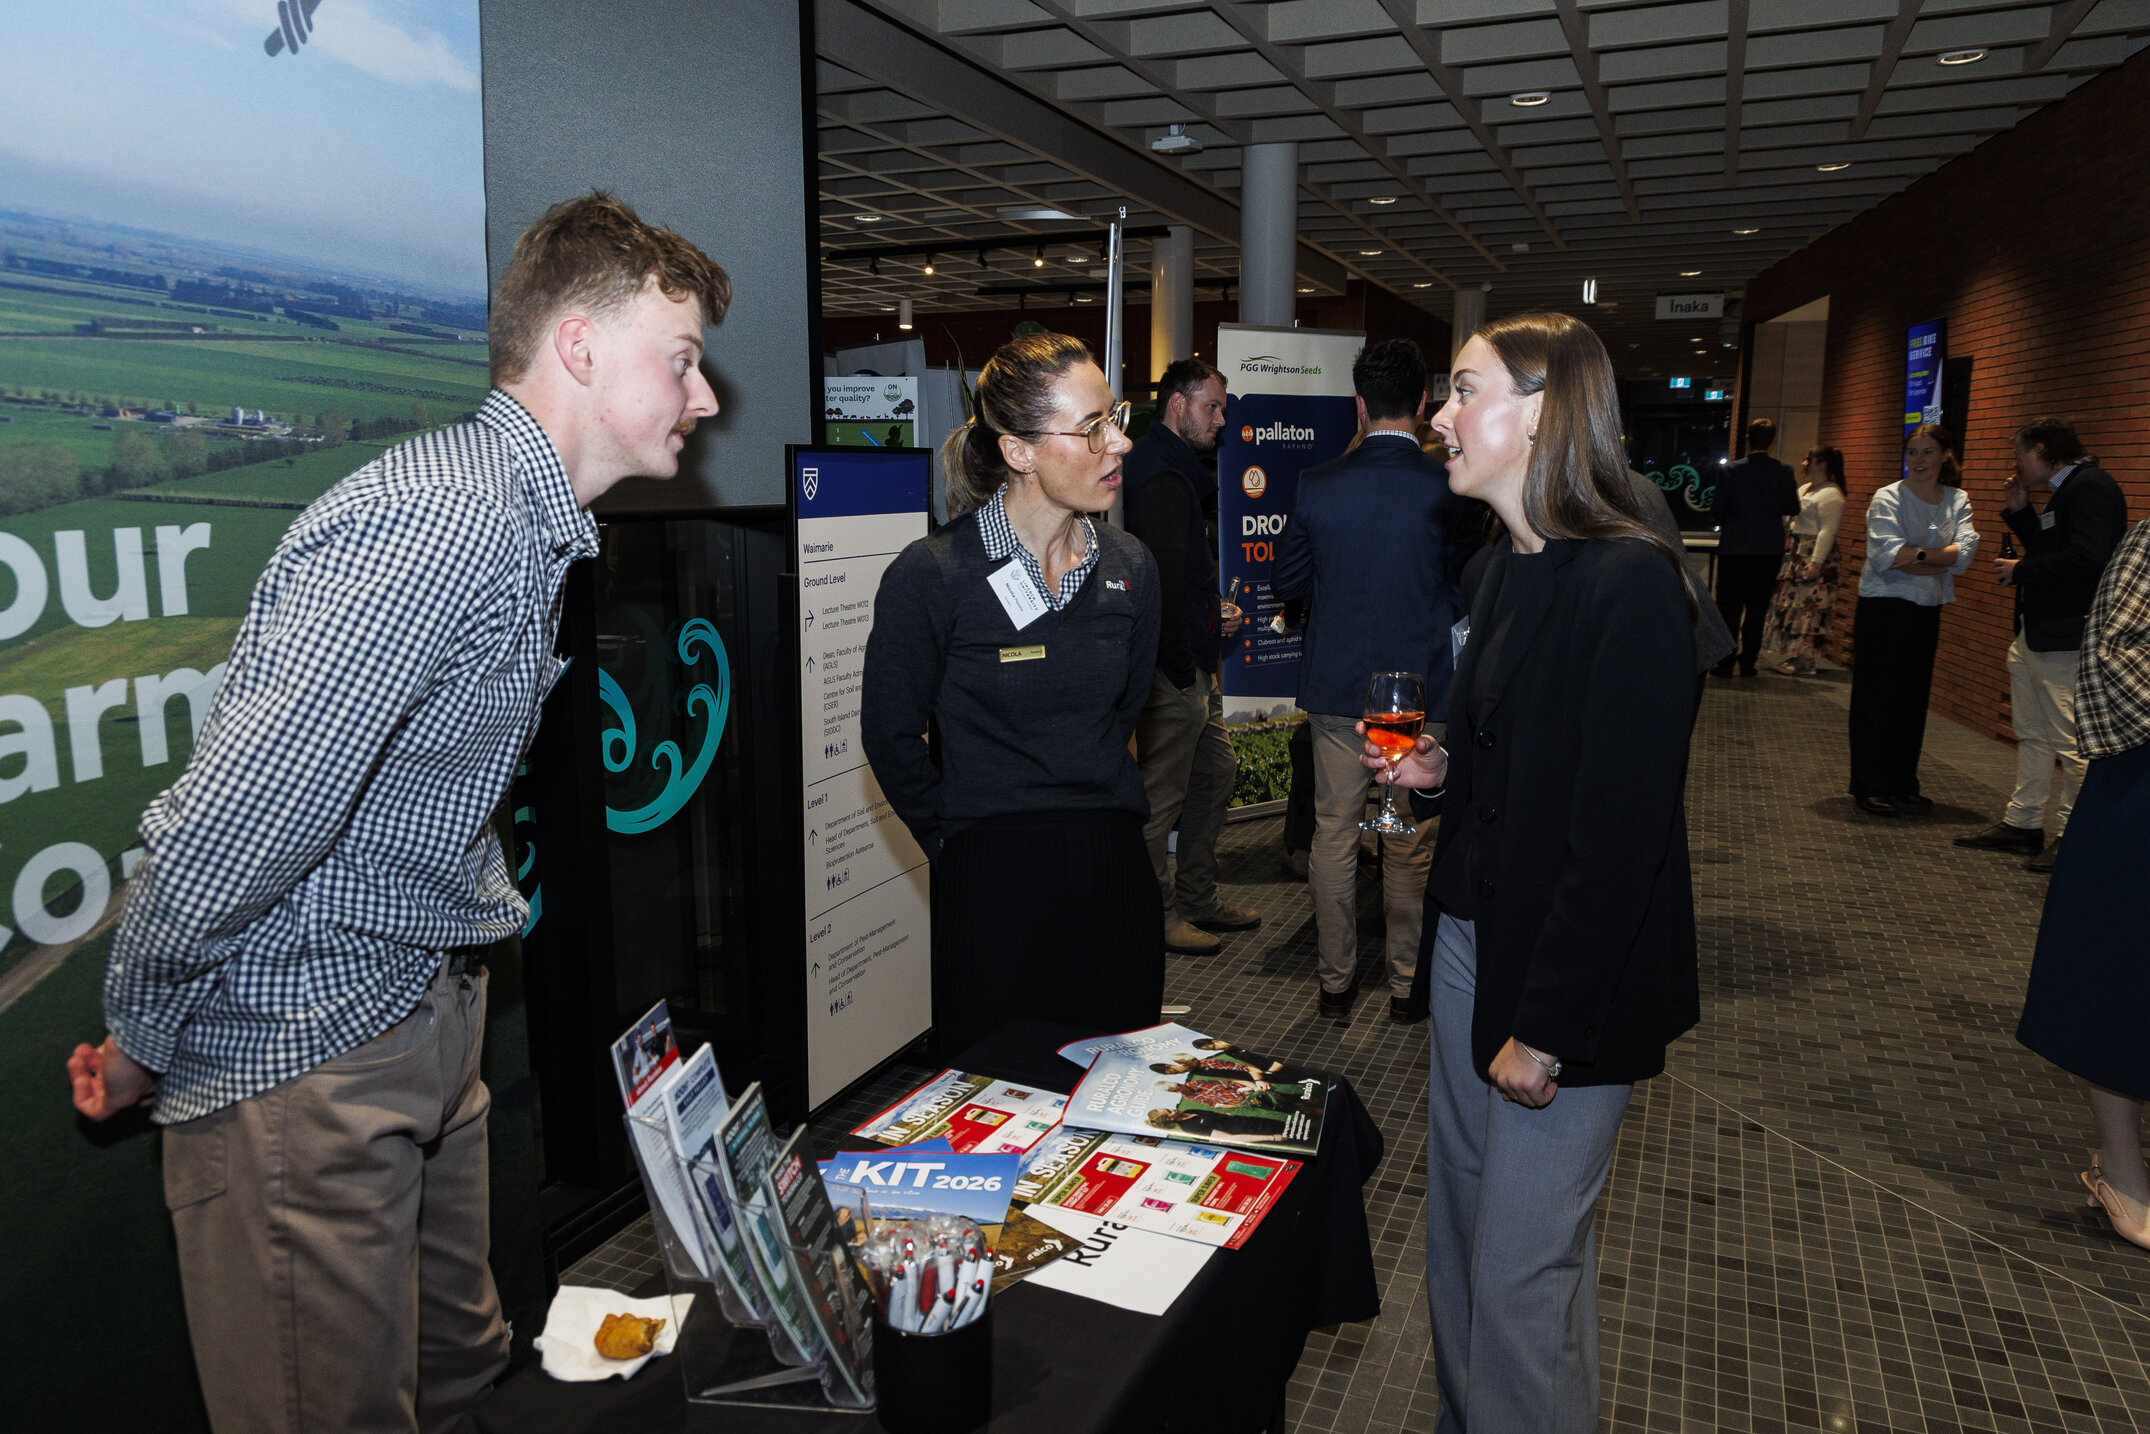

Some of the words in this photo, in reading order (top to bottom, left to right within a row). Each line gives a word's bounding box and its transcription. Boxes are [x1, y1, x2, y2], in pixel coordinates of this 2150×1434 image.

[1240, 363, 1259, 372] PGG
[827, 385, 842, 394] you
[843, 384, 875, 394] improve
[839, 394, 871, 404] quality?
[1256, 421, 1315, 446] pallaton
[803, 542, 834, 554] Waimarie
[804, 574, 828, 588] Ground
[829, 572, 846, 584] Level
[822, 606, 840, 615] Lecture
[840, 602, 857, 612] Theatre
[822, 621, 840, 630] Lecture
[840, 617, 857, 627] Theatre
[1002, 651, 1022, 659] NICOLA
[1257, 654, 1269, 662] High
[1269, 652, 1280, 660] stock
[808, 793, 824, 810] Level
[824, 792, 828, 803] 1
[825, 814, 851, 831] Department
[856, 806, 865, 817] Soil
[825, 834, 838, 845] Head
[825, 841, 846, 855] Sciences
[825, 850, 855, 870] Bioprotection
[810, 925, 827, 944] Level
[827, 923, 833, 934] 2
[828, 941, 854, 961] Department
[837, 946, 866, 967] Conservation
[828, 973, 840, 985] Head
[838, 968, 866, 990] Conservation
[1085, 1037, 1157, 1055] RURALCO
[1086, 1072, 1122, 1112] RURALCO
[1107, 1067, 1145, 1116] AGRONOMY
[1300, 1082, 1313, 1100] Ruralco
[878, 1125, 911, 1142] IN
[902, 1081, 976, 1127] SEASON
[1127, 1090, 1155, 1118] GUIDE
[777, 1156, 801, 1196] SWITCH
[835, 1167, 851, 1180] THE
[848, 1160, 946, 1188] KIT
[932, 1175, 1002, 1191] 2026
[1012, 1179, 1043, 1198] IN
